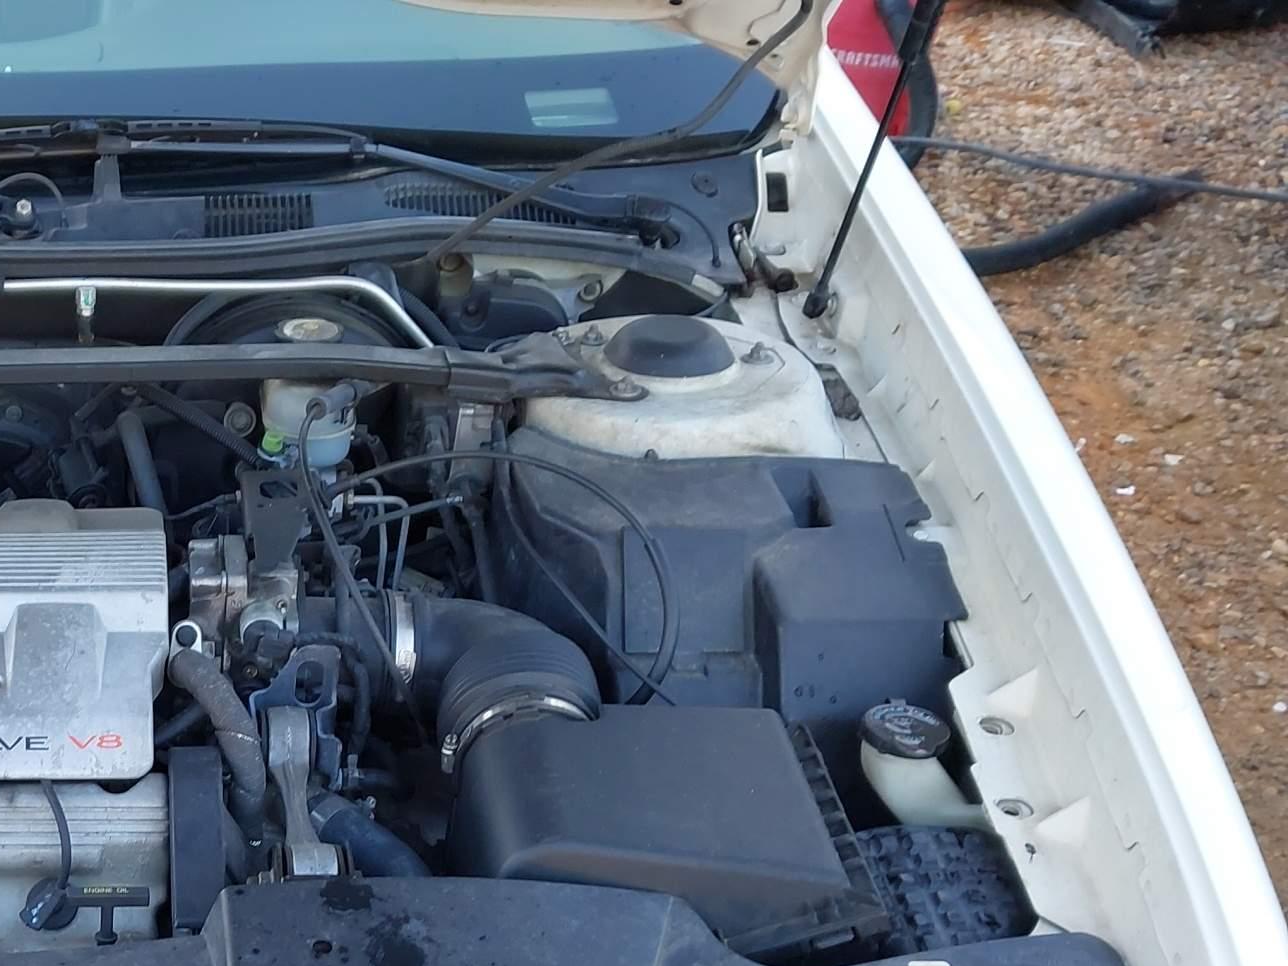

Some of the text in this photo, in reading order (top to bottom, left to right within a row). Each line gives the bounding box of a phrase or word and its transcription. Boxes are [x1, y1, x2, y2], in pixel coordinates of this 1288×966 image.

[831, 48, 900, 68] RAFTSMA
[68, 734, 123, 750] V8
[83, 887, 112, 895] ENGINE
